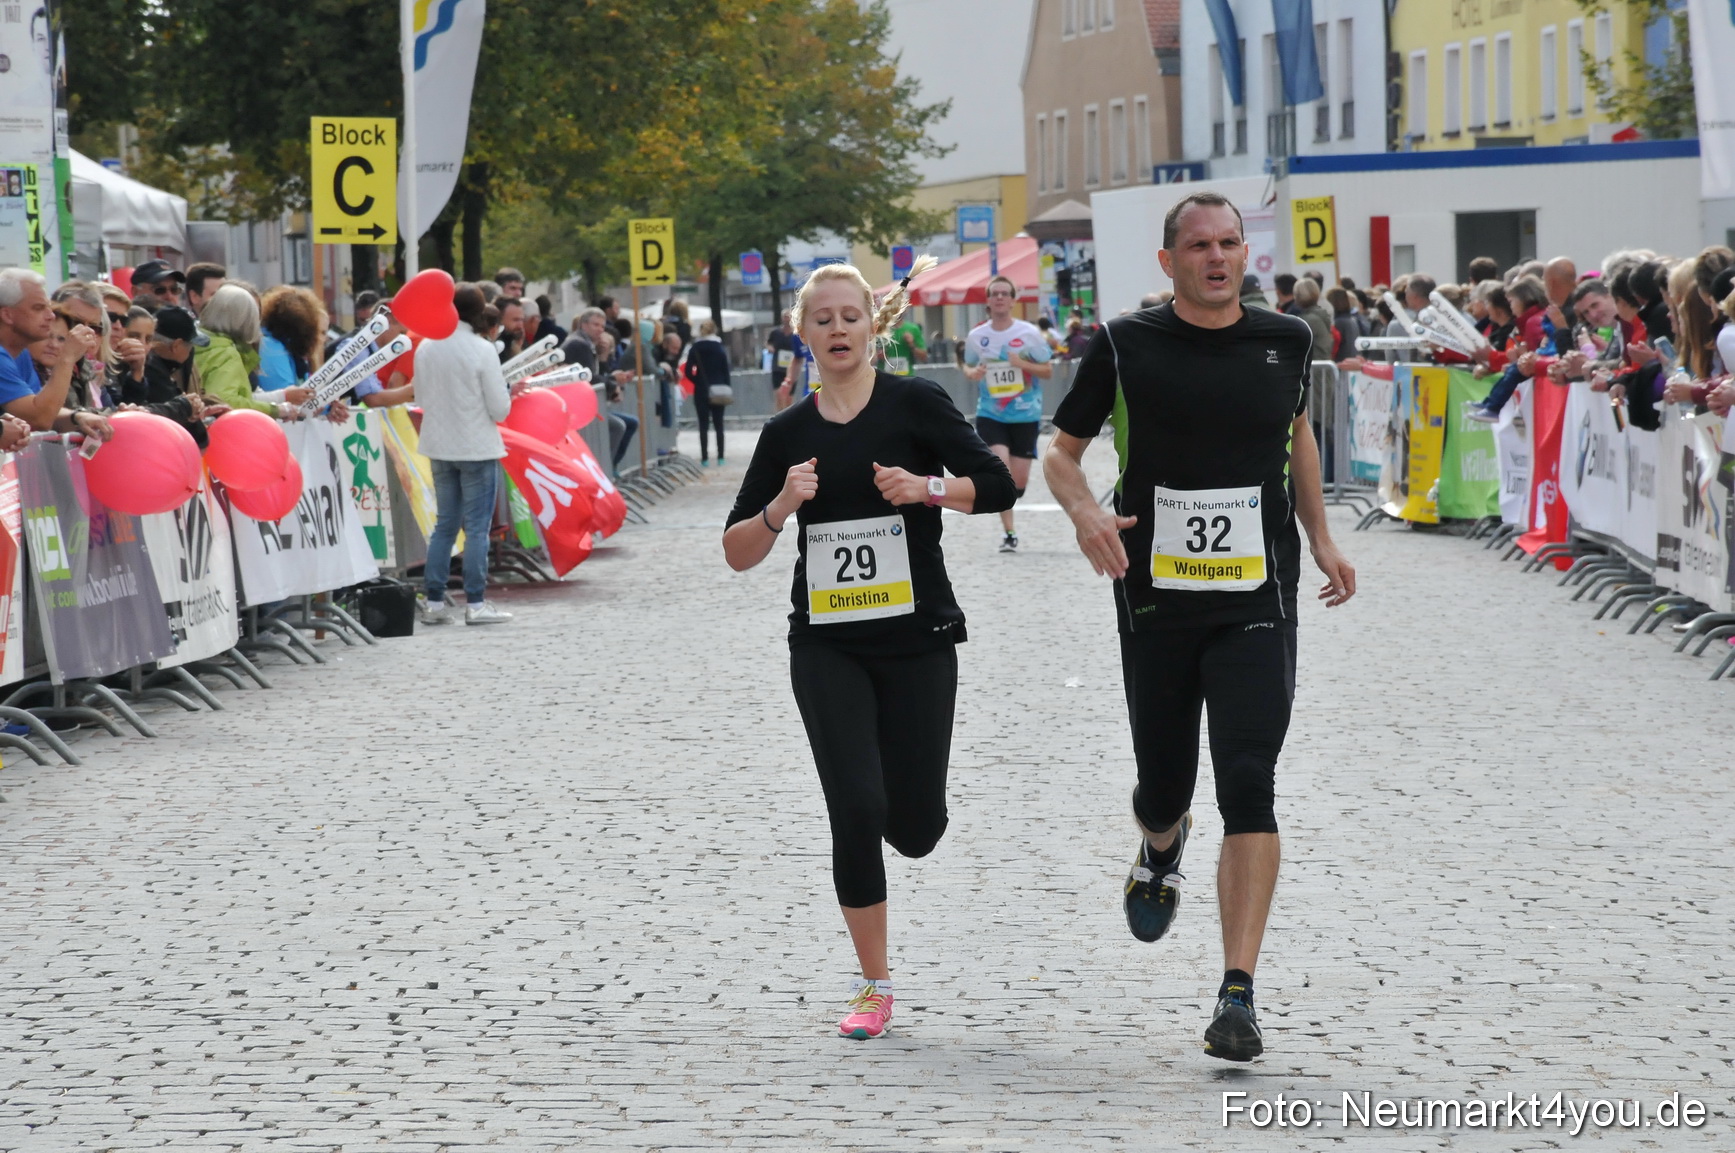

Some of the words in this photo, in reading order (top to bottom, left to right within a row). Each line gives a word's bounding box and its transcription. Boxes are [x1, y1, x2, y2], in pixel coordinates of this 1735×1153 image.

[322, 123, 386, 146] Block
[333, 155, 375, 217] C
[1296, 200, 1331, 213] Block
[635, 222, 667, 235] Block
[1303, 217, 1327, 249] D
[642, 239, 664, 271] D
[993, 370, 1015, 384] 140
[1157, 497, 1190, 511] PARTL
[1193, 499, 1245, 511] Neumarkt
[808, 532, 835, 545] PARTL
[837, 528, 887, 542] Neumarkt
[1185, 515, 1232, 553] 32
[834, 544, 877, 584] 29
[1174, 560, 1243, 580] Wolfgang
[829, 591, 890, 609] Christina
